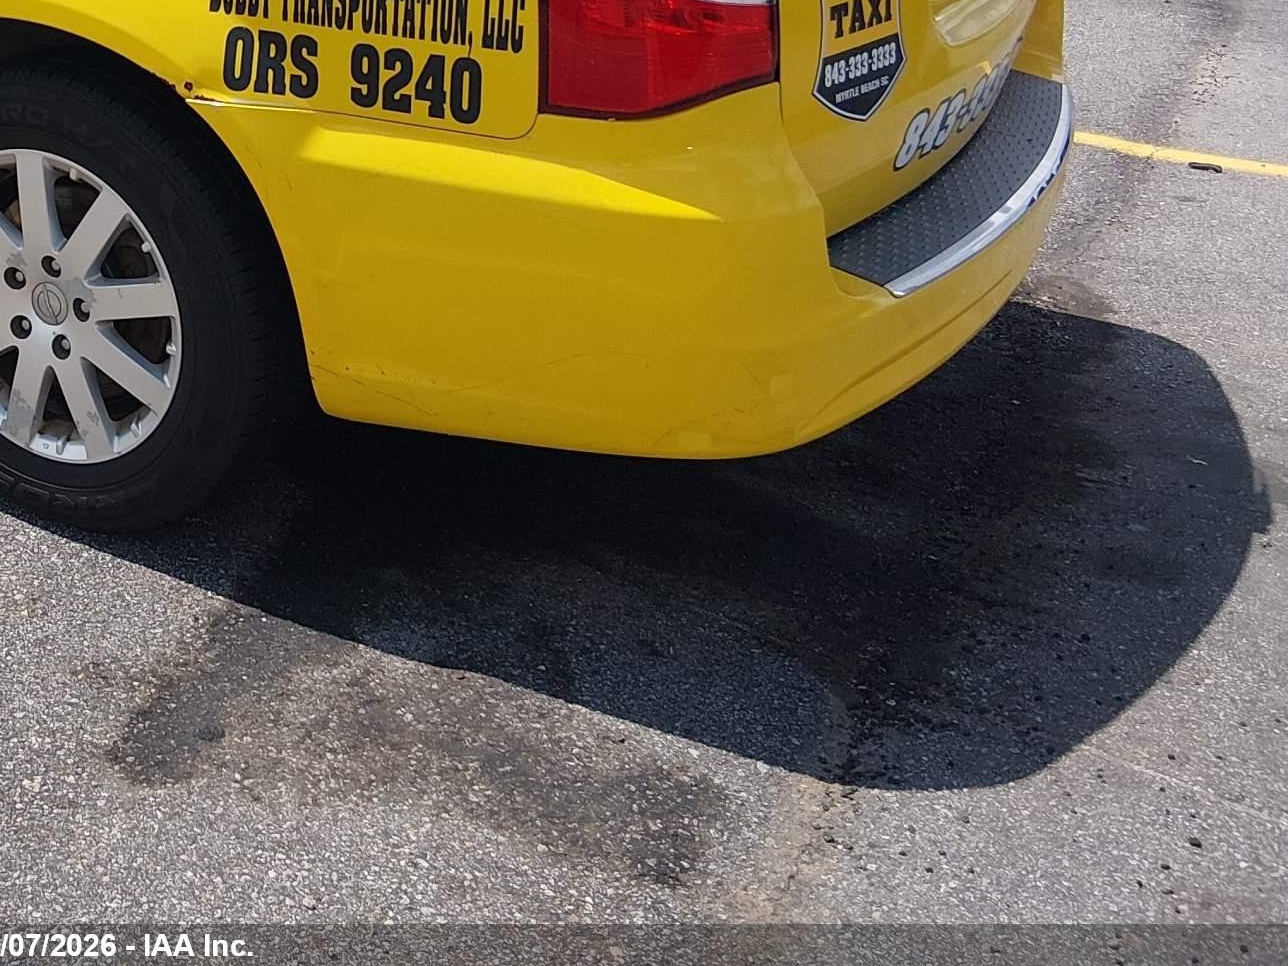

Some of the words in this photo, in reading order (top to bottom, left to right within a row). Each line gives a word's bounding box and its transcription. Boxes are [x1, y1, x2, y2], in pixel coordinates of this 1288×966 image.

[222, 26, 319, 99] ORS
[350, 42, 483, 125] 9240
[824, 41, 896, 88] 843-333-3333
[835, 86, 860, 104] MYRTLE
[860, 78, 880, 94] BEACH
